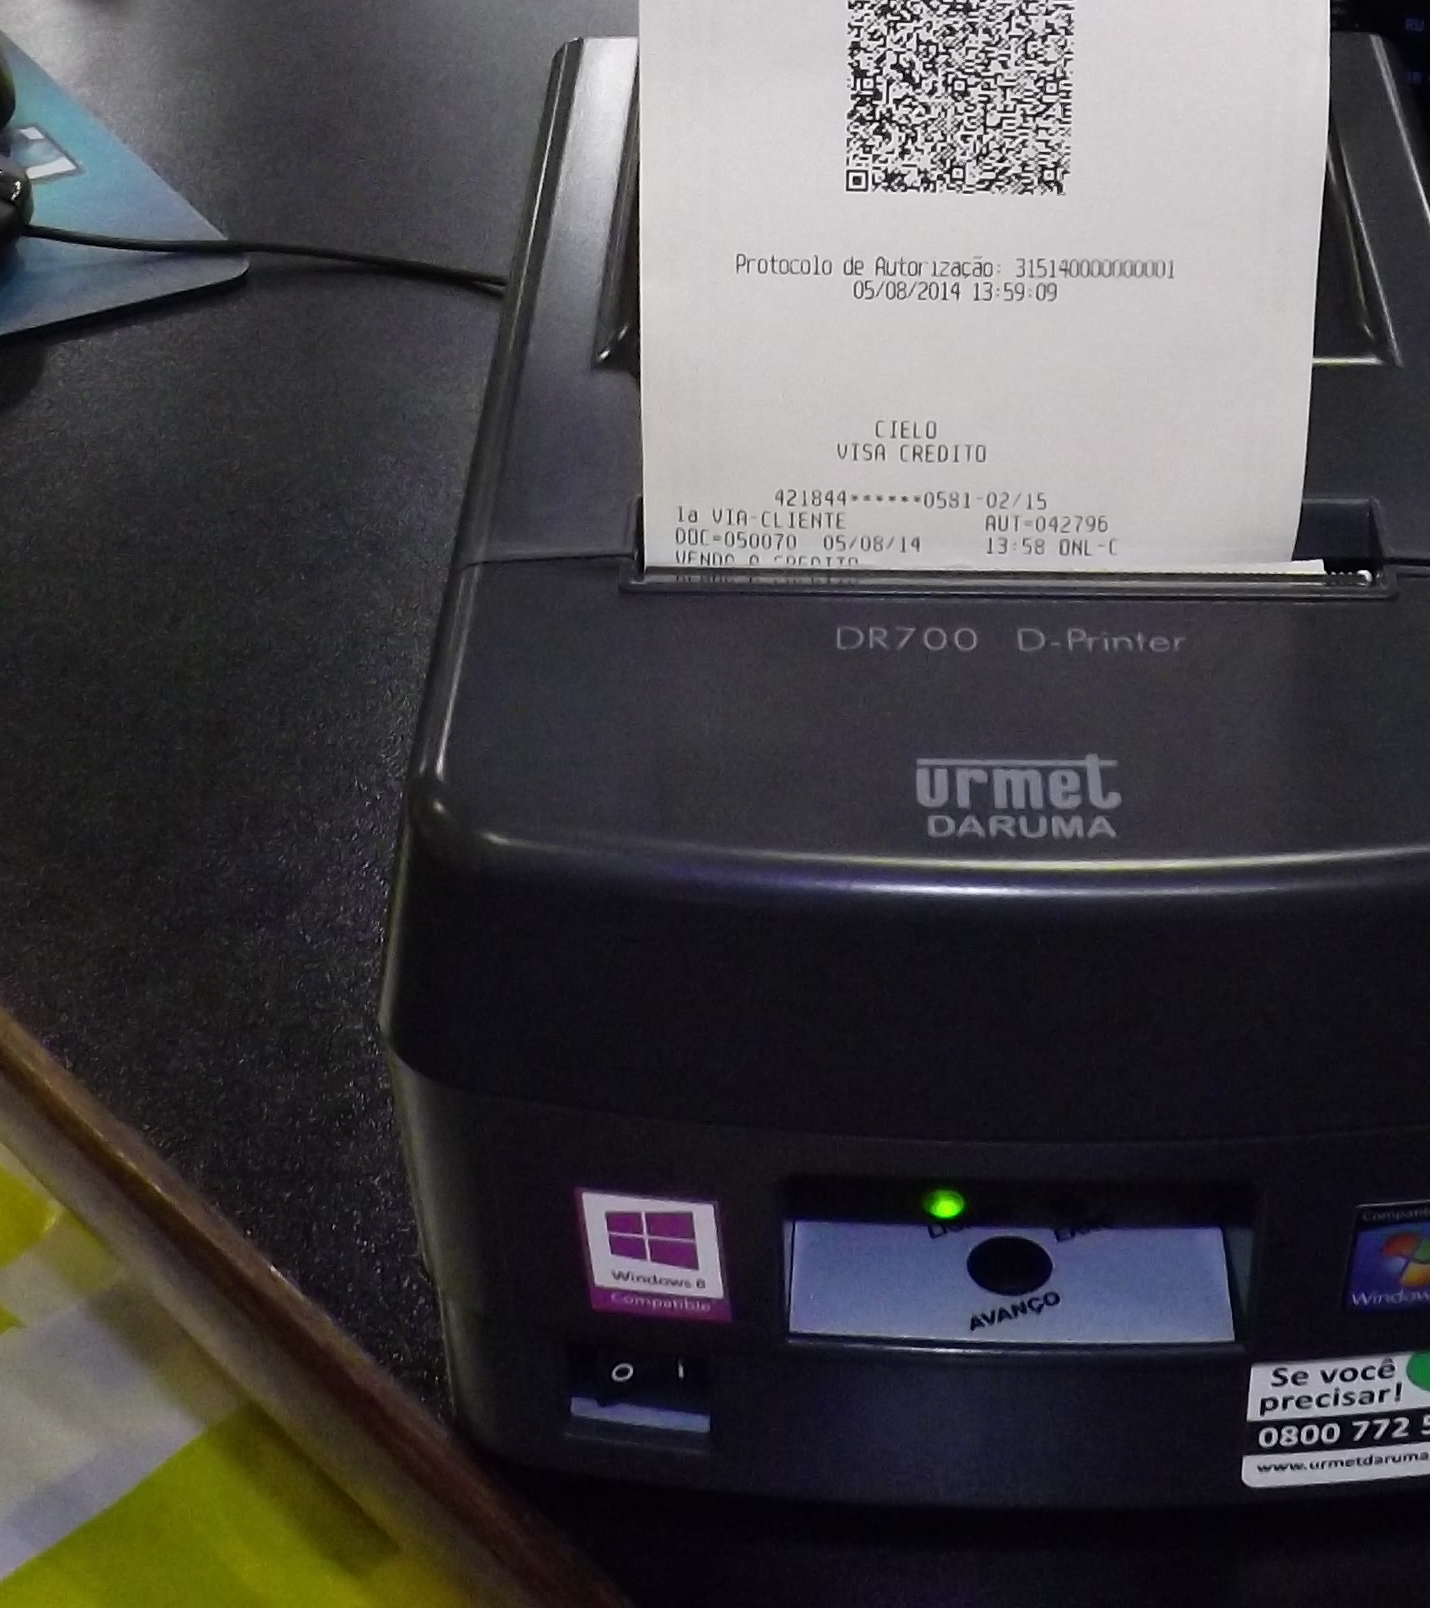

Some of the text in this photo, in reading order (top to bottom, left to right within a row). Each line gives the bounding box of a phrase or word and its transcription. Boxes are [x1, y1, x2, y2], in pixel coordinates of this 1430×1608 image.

[734, 253, 1004, 281] Protocolo de Autorização:
[851, 280, 1059, 304] 05/08/2014 13:59:09
[874, 419, 938, 440] CIELO
[836, 442, 988, 464] VISA CREDITO
[711, 507, 1110, 534] VIA-CLIENTE AUT=042796
[674, 527, 1046, 557] DOC=050070 05/08/14 13:58
[836, 626, 1187, 654] DR700 D-Printer
[916, 753, 1122, 810] urmet
[927, 815, 1118, 839] DARUMA
[611, 1269, 692, 1290] Windows
[610, 1291, 712, 1314] Compatible
[969, 1290, 1062, 1332] AVANÇO
[1270, 1356, 1396, 1389] Se você
[1258, 1381, 1404, 1417] precisar!
[1257, 1422, 1342, 1450] 0800
[1351, 1416, 1411, 1443] 772
